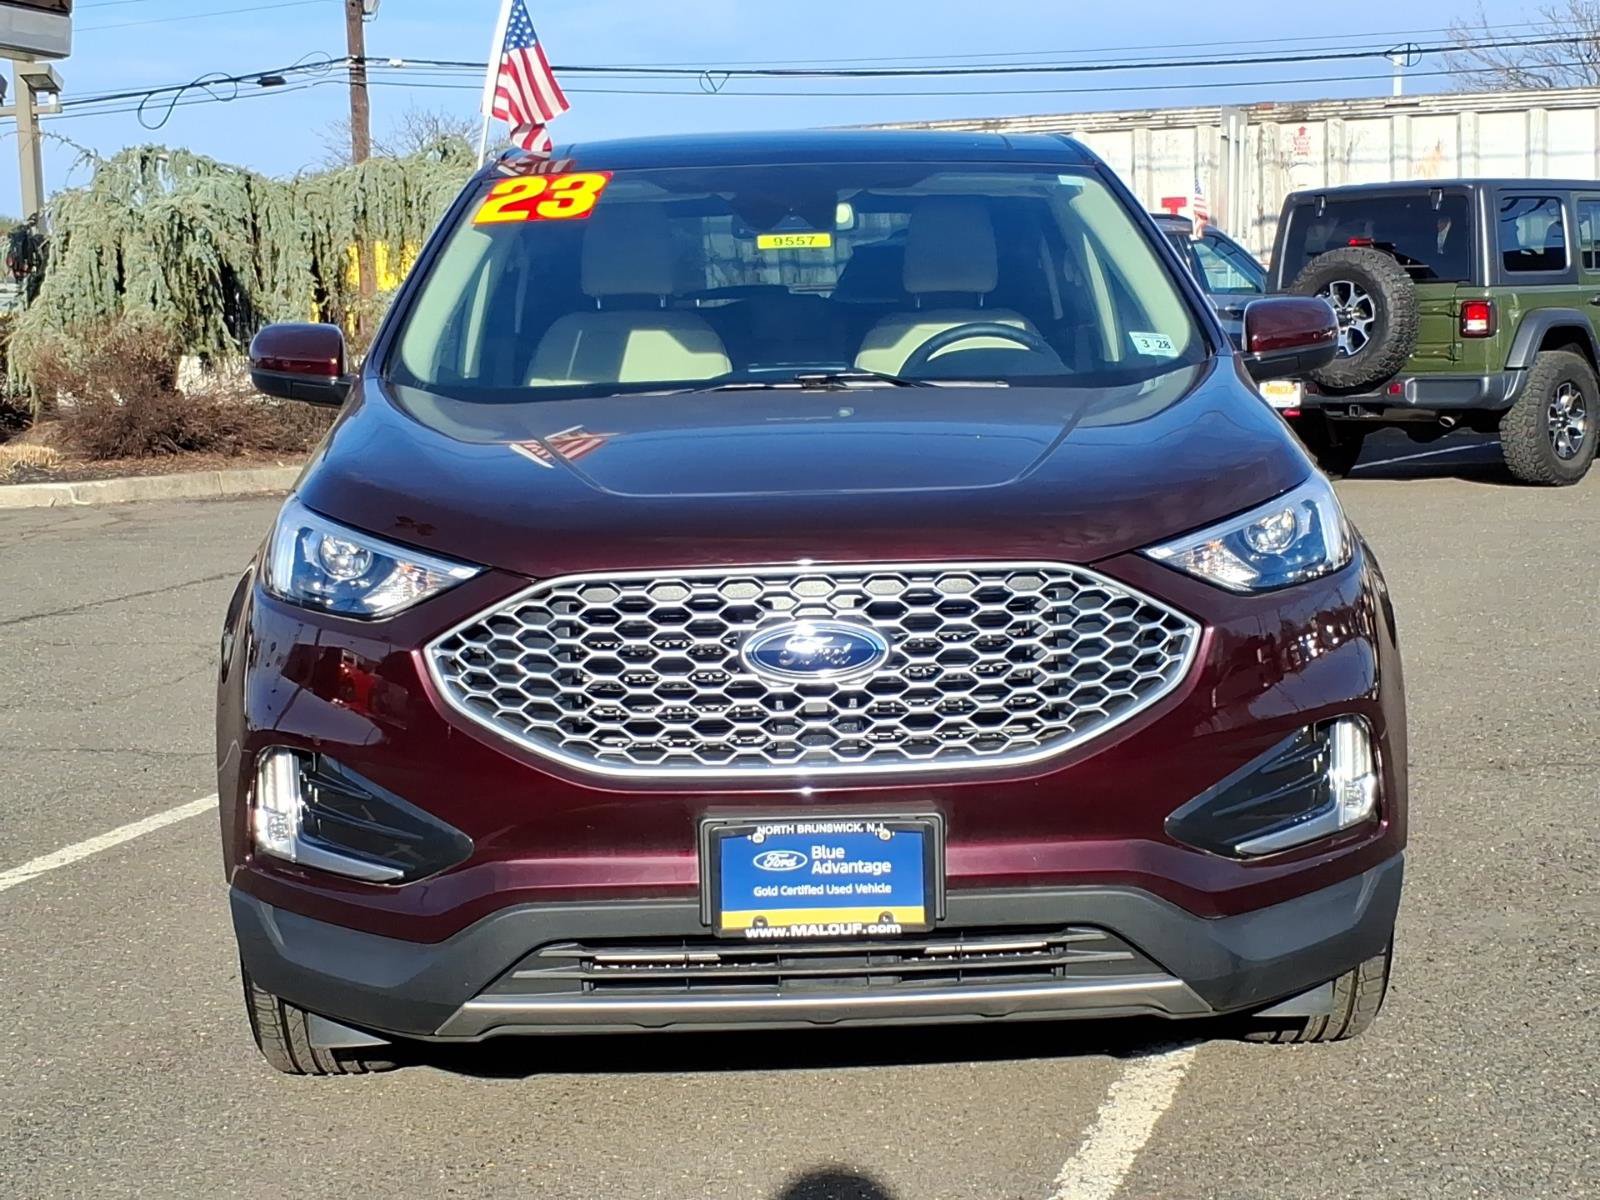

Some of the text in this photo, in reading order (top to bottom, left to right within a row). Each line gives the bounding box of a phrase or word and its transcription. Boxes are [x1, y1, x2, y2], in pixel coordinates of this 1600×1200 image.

[474, 174, 607, 223] 23
[773, 236, 816, 246] 9557
[1140, 339, 1171, 349] 3 28
[757, 825, 794, 835] NORTH
[812, 845, 845, 859] Blue
[763, 853, 798, 868] Ford
[812, 860, 891, 876] Advantage
[753, 882, 892, 897] Gold Certified Used Vehicle
[745, 923, 902, 938] www.MALOUF.com
